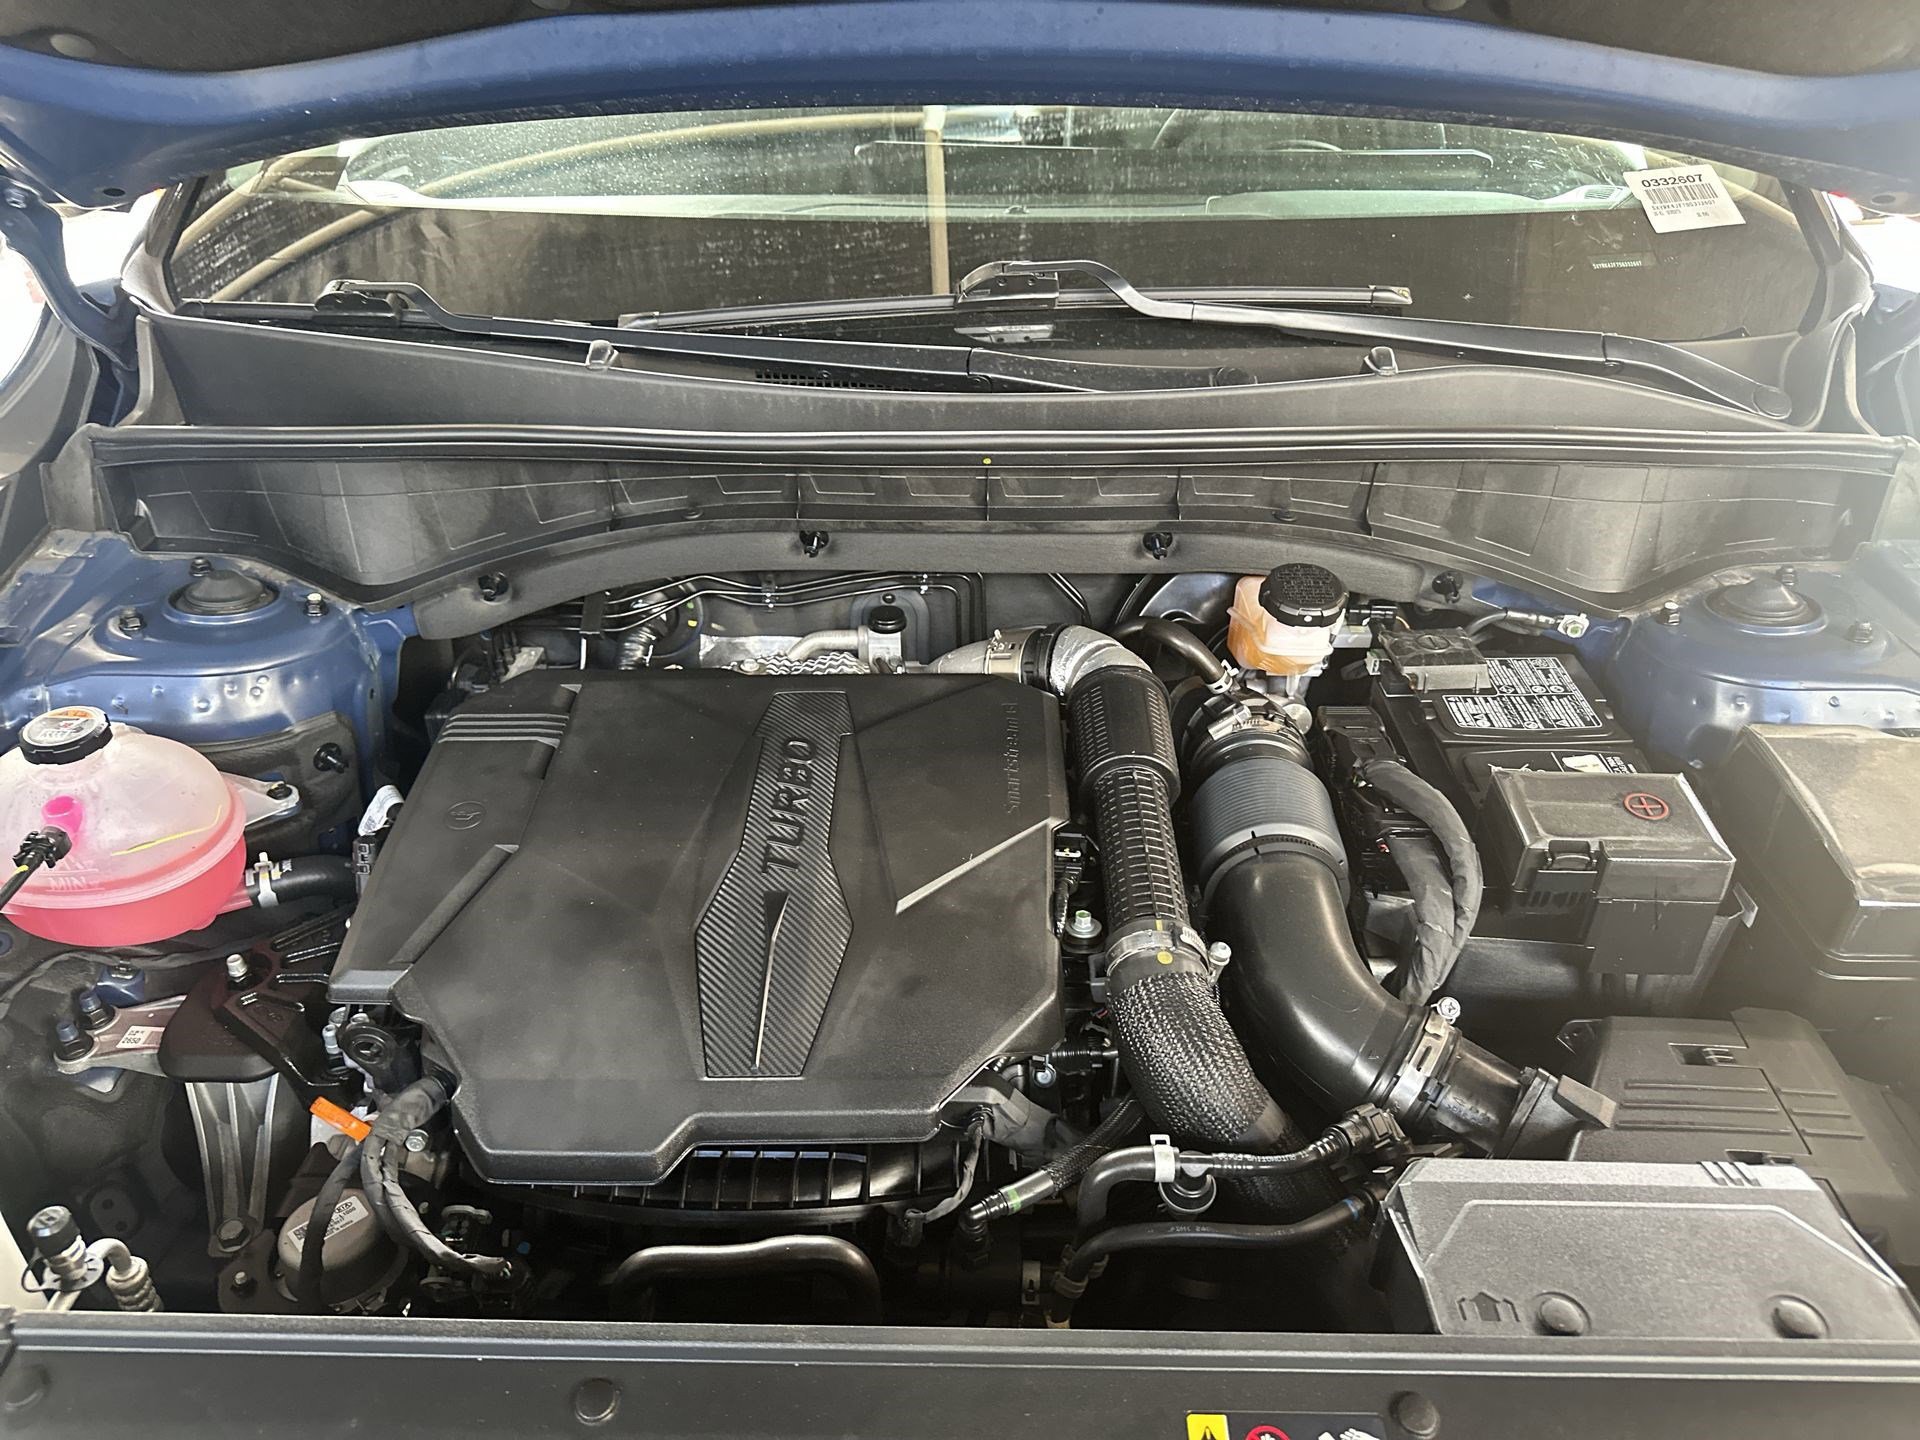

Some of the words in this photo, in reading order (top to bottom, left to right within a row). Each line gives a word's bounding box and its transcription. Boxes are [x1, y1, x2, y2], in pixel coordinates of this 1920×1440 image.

[1641, 174, 1702, 188] 0332607
[761, 738, 817, 874] TURBO
[48, 876, 87, 891] MIN
